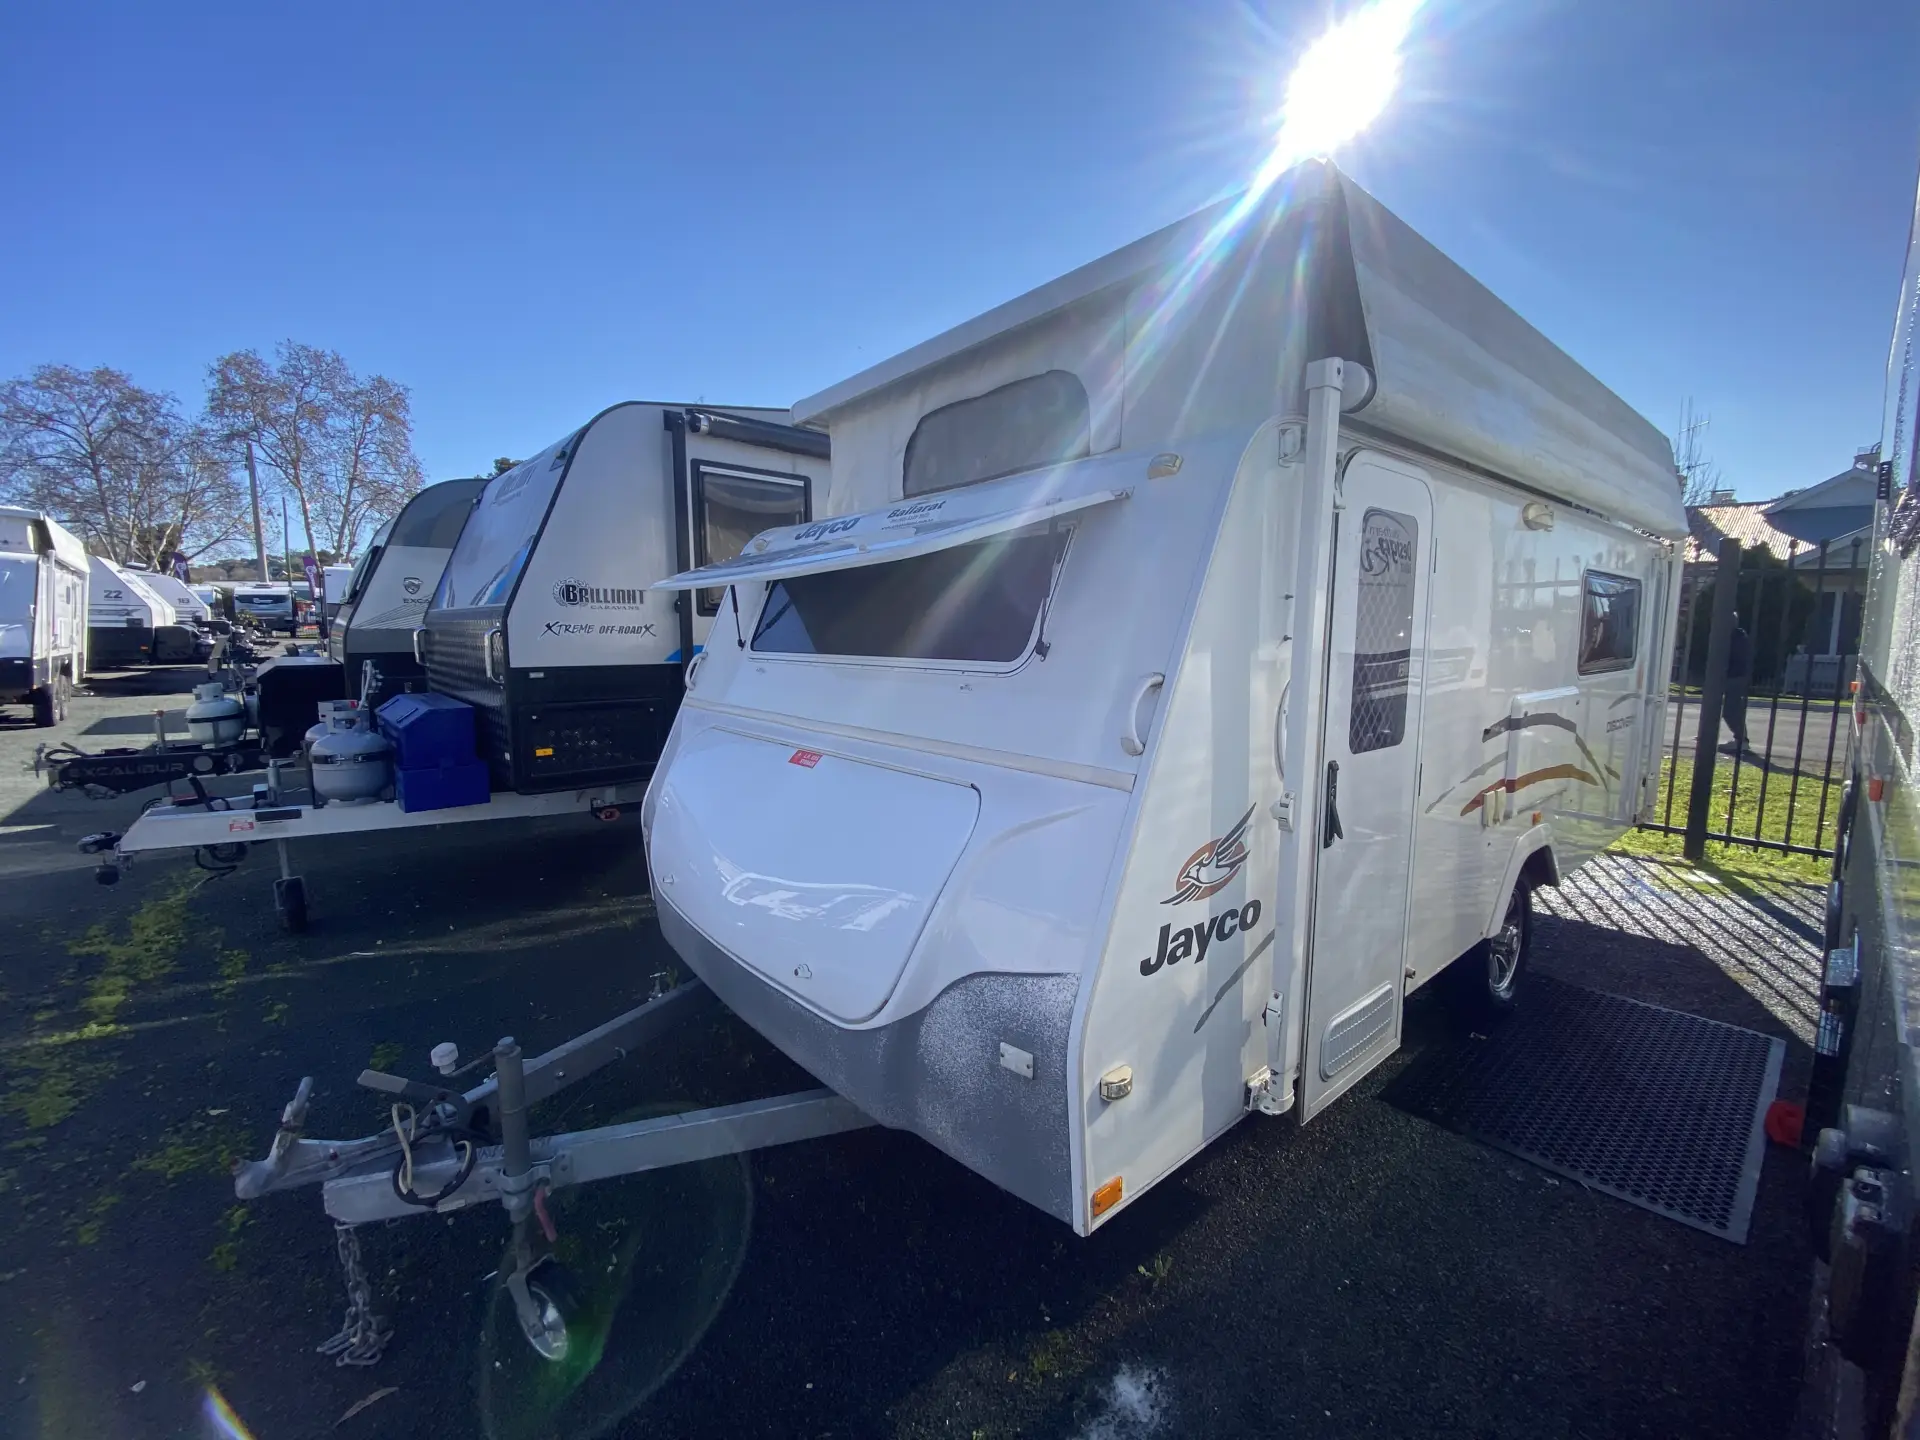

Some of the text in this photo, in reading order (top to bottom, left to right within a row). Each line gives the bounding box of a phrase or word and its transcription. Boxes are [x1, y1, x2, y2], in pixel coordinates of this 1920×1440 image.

[887, 500, 946, 519] Ballarat
[794, 517, 861, 541] Jayco
[68, 762, 185, 778] EXCALIBUR
[1139, 899, 1262, 977] Jayco
